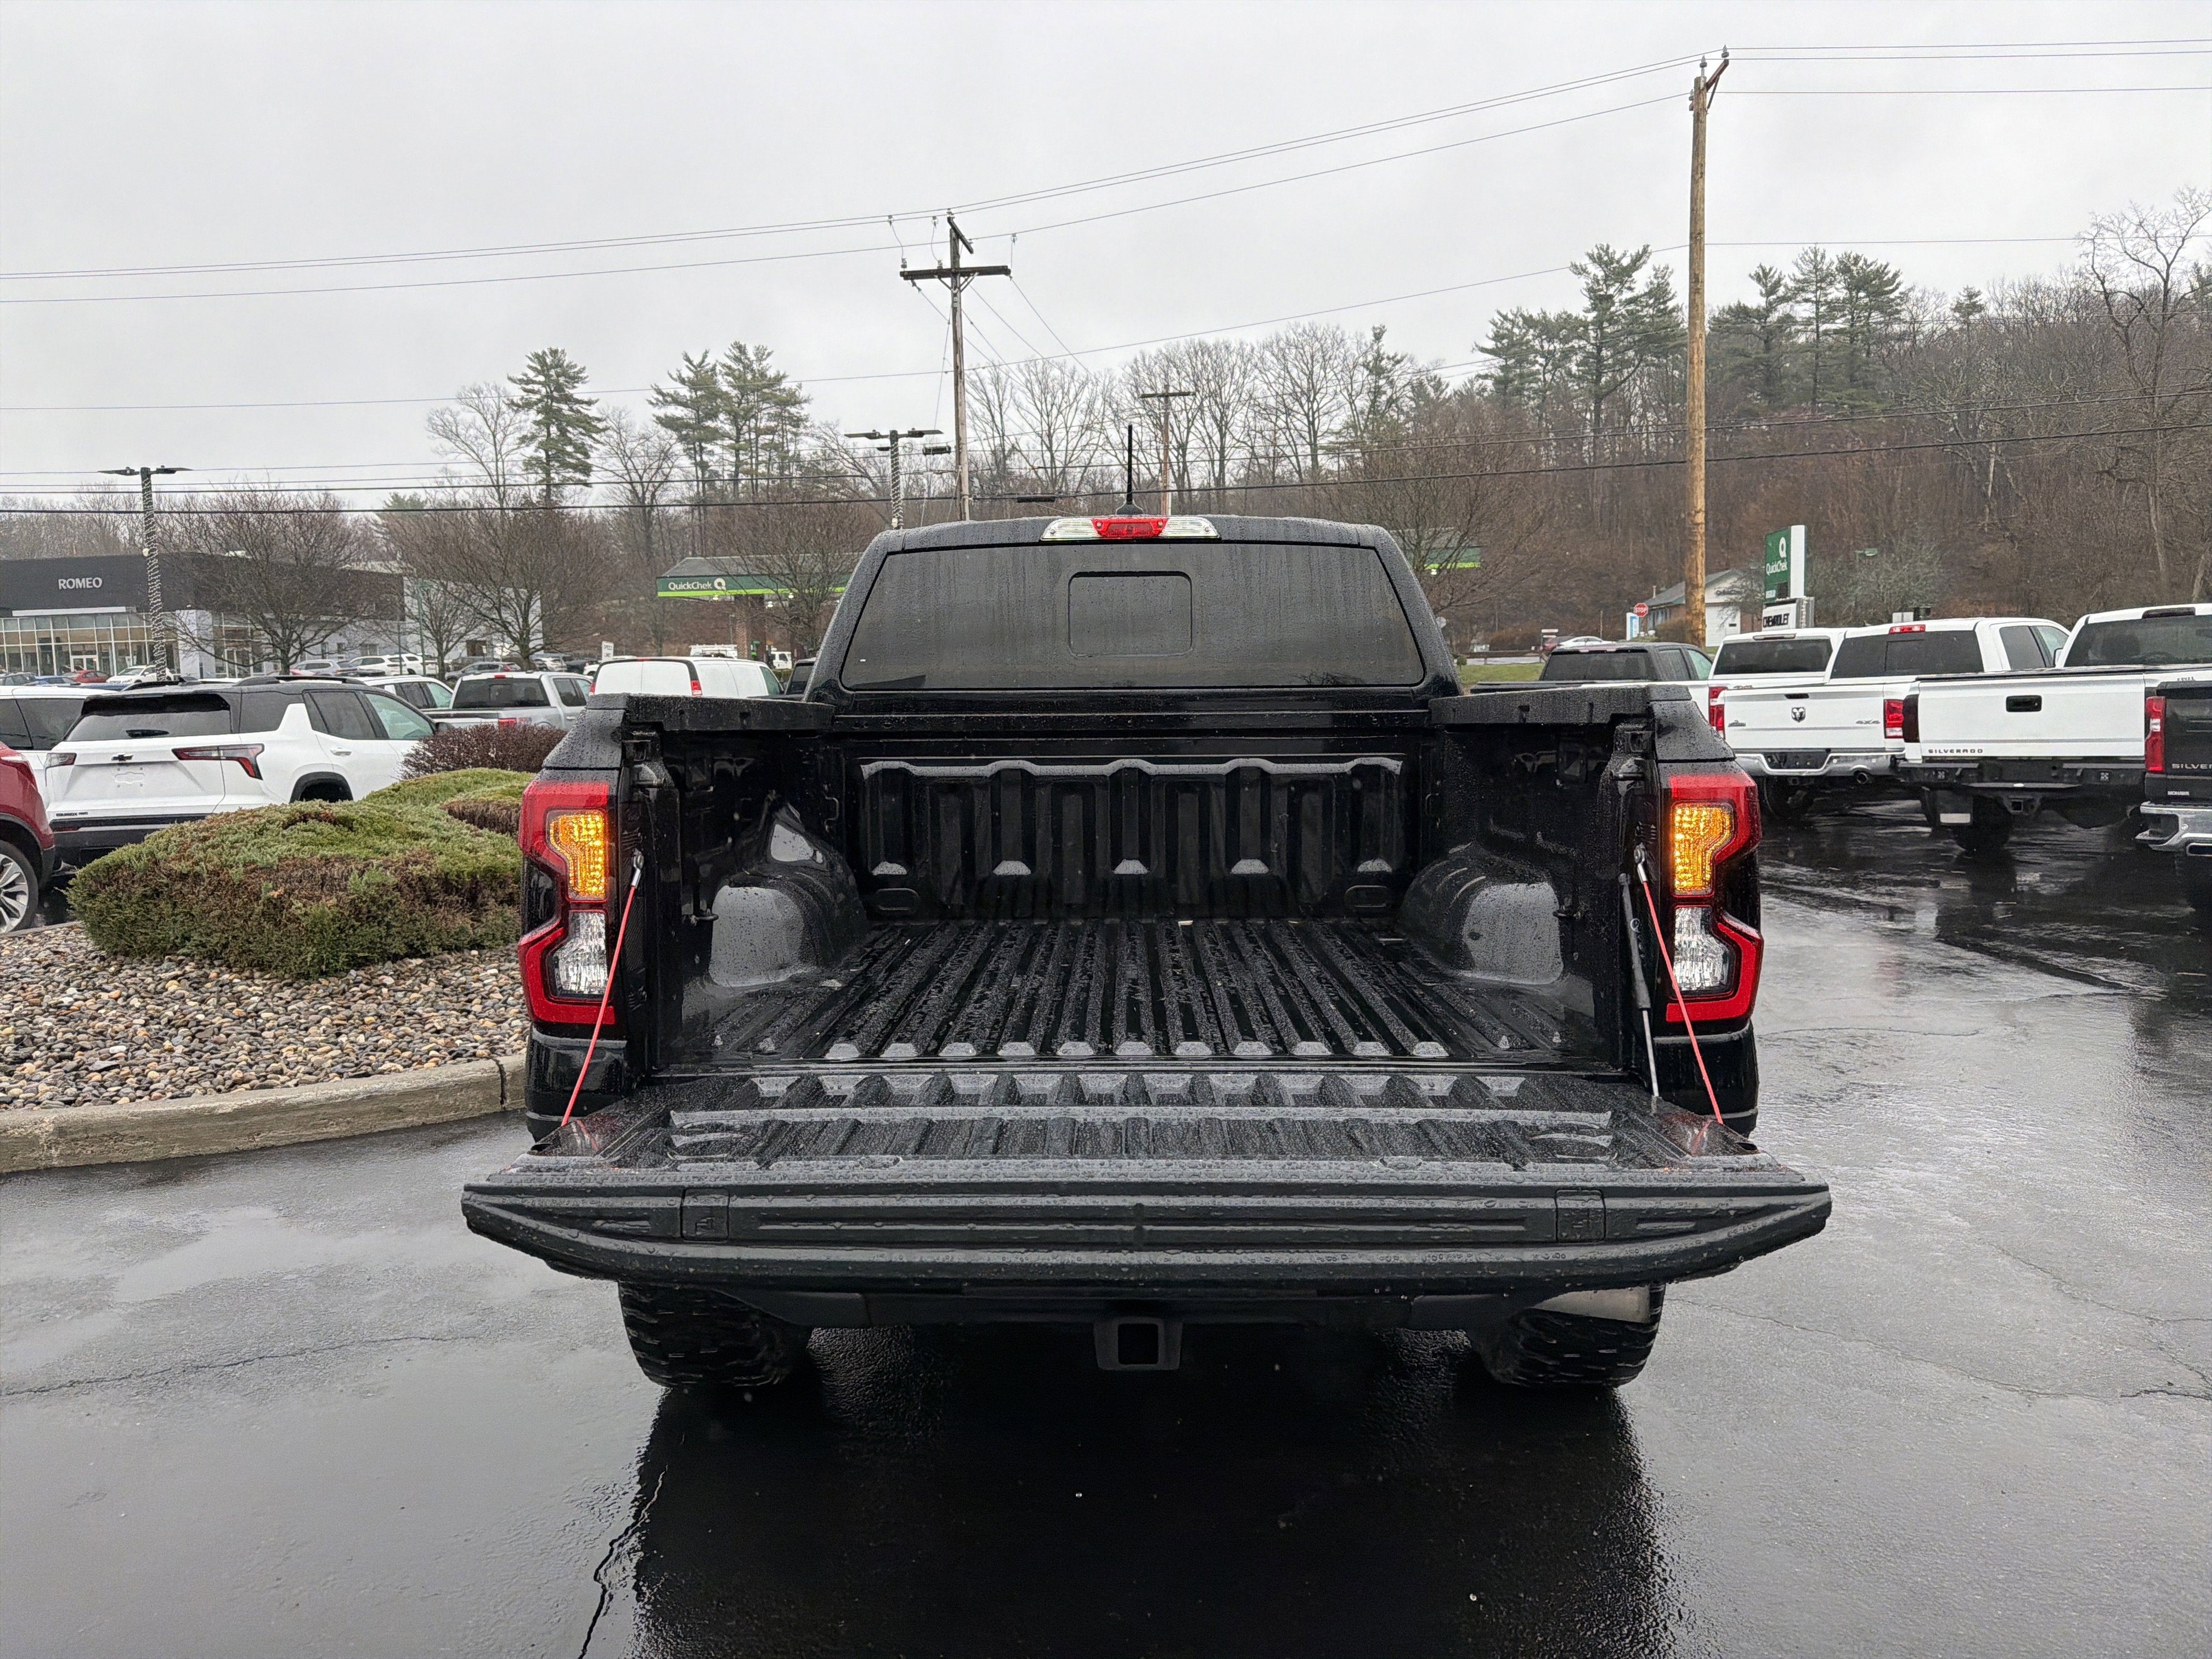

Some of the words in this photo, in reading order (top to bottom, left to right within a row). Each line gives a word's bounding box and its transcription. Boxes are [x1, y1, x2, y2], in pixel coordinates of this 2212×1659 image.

[1765, 558, 1788, 576] QuickChek
[58, 577, 103, 590] ROMEO
[668, 582, 712, 591] QuickChek
[1763, 613, 1790, 628] CHEVROLET
